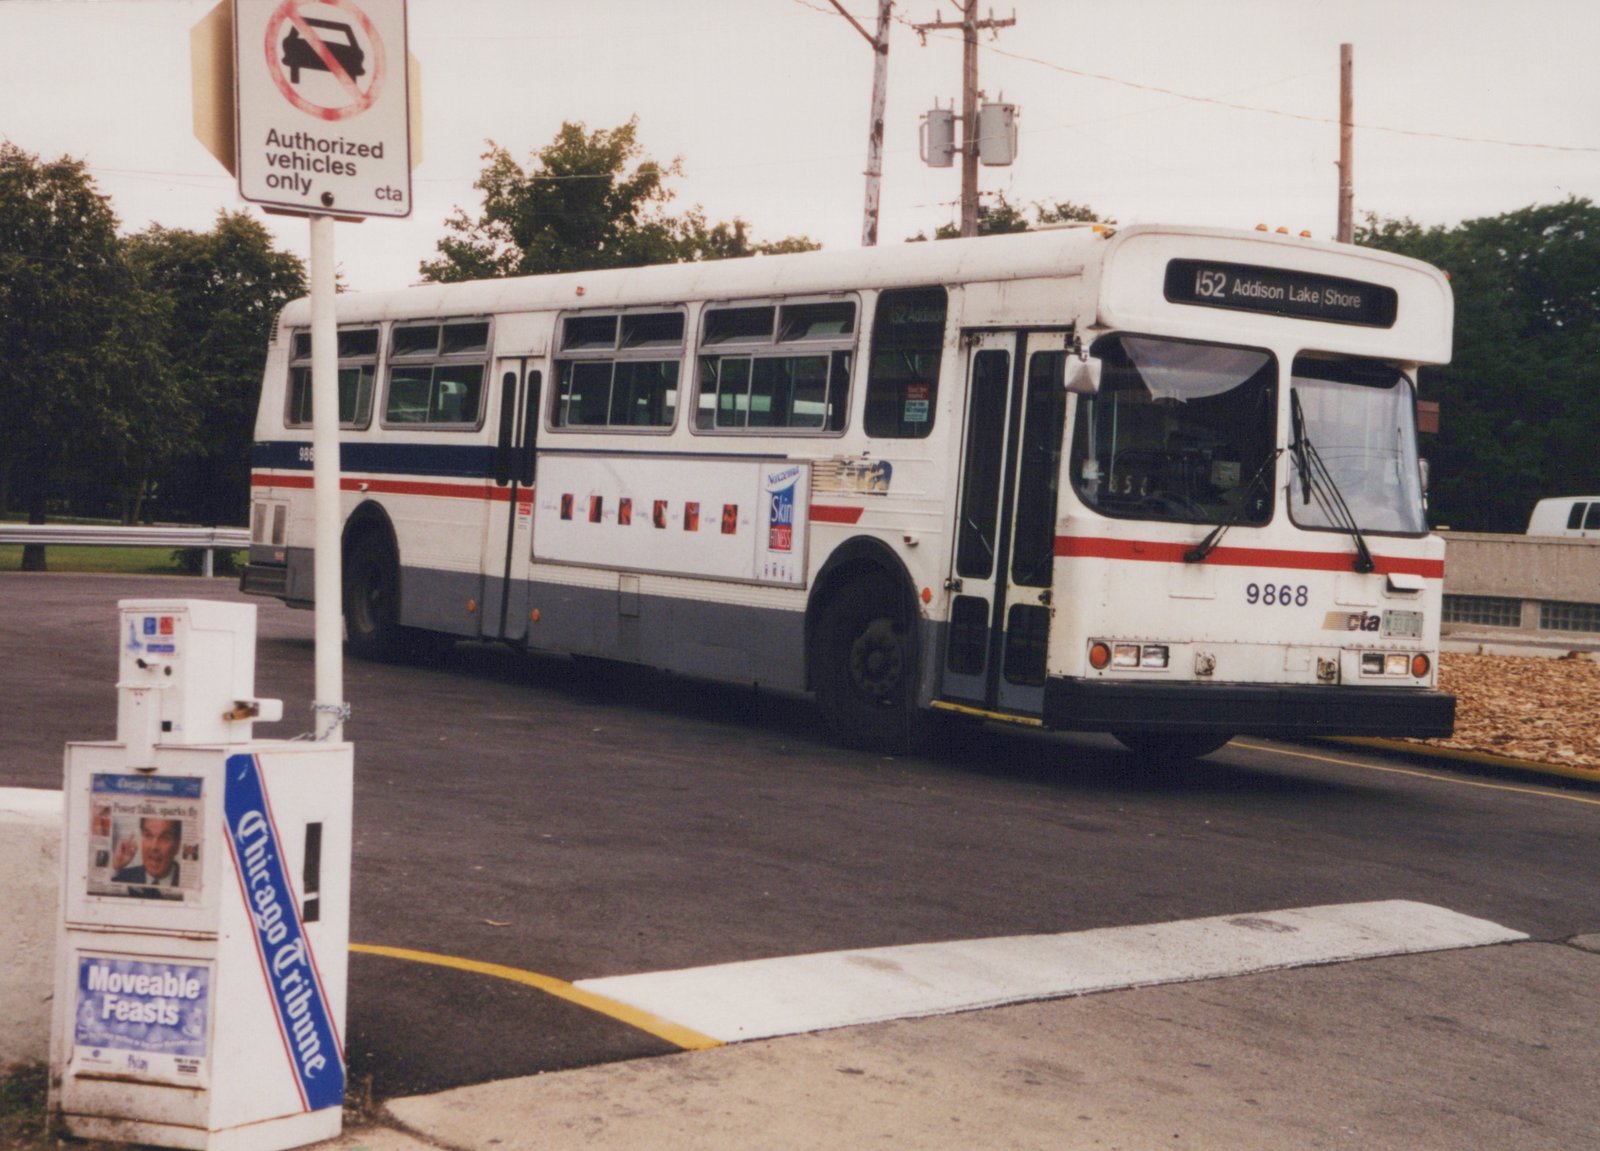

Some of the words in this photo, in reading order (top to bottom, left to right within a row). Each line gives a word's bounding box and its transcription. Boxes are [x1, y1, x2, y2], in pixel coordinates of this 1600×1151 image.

[265, 128, 384, 159] Authorized
[266, 152, 357, 176] vehicles
[266, 172, 313, 196] only
[375, 185, 402, 201] cta
[1194, 270, 1227, 298] 152
[1232, 278, 1284, 300] Addison
[1289, 284, 1319, 304] Lake
[1325, 289, 1361, 308] Shore
[299, 447, 315, 462] 986
[771, 494, 793, 523] Skin
[1246, 583, 1309, 607] 9868
[1347, 611, 1380, 632] cta
[237, 810, 288, 945] Chicago
[272, 936, 327, 1079] Tribune
[87, 965, 200, 999] Moveable
[101, 994, 180, 1025] Feasts
